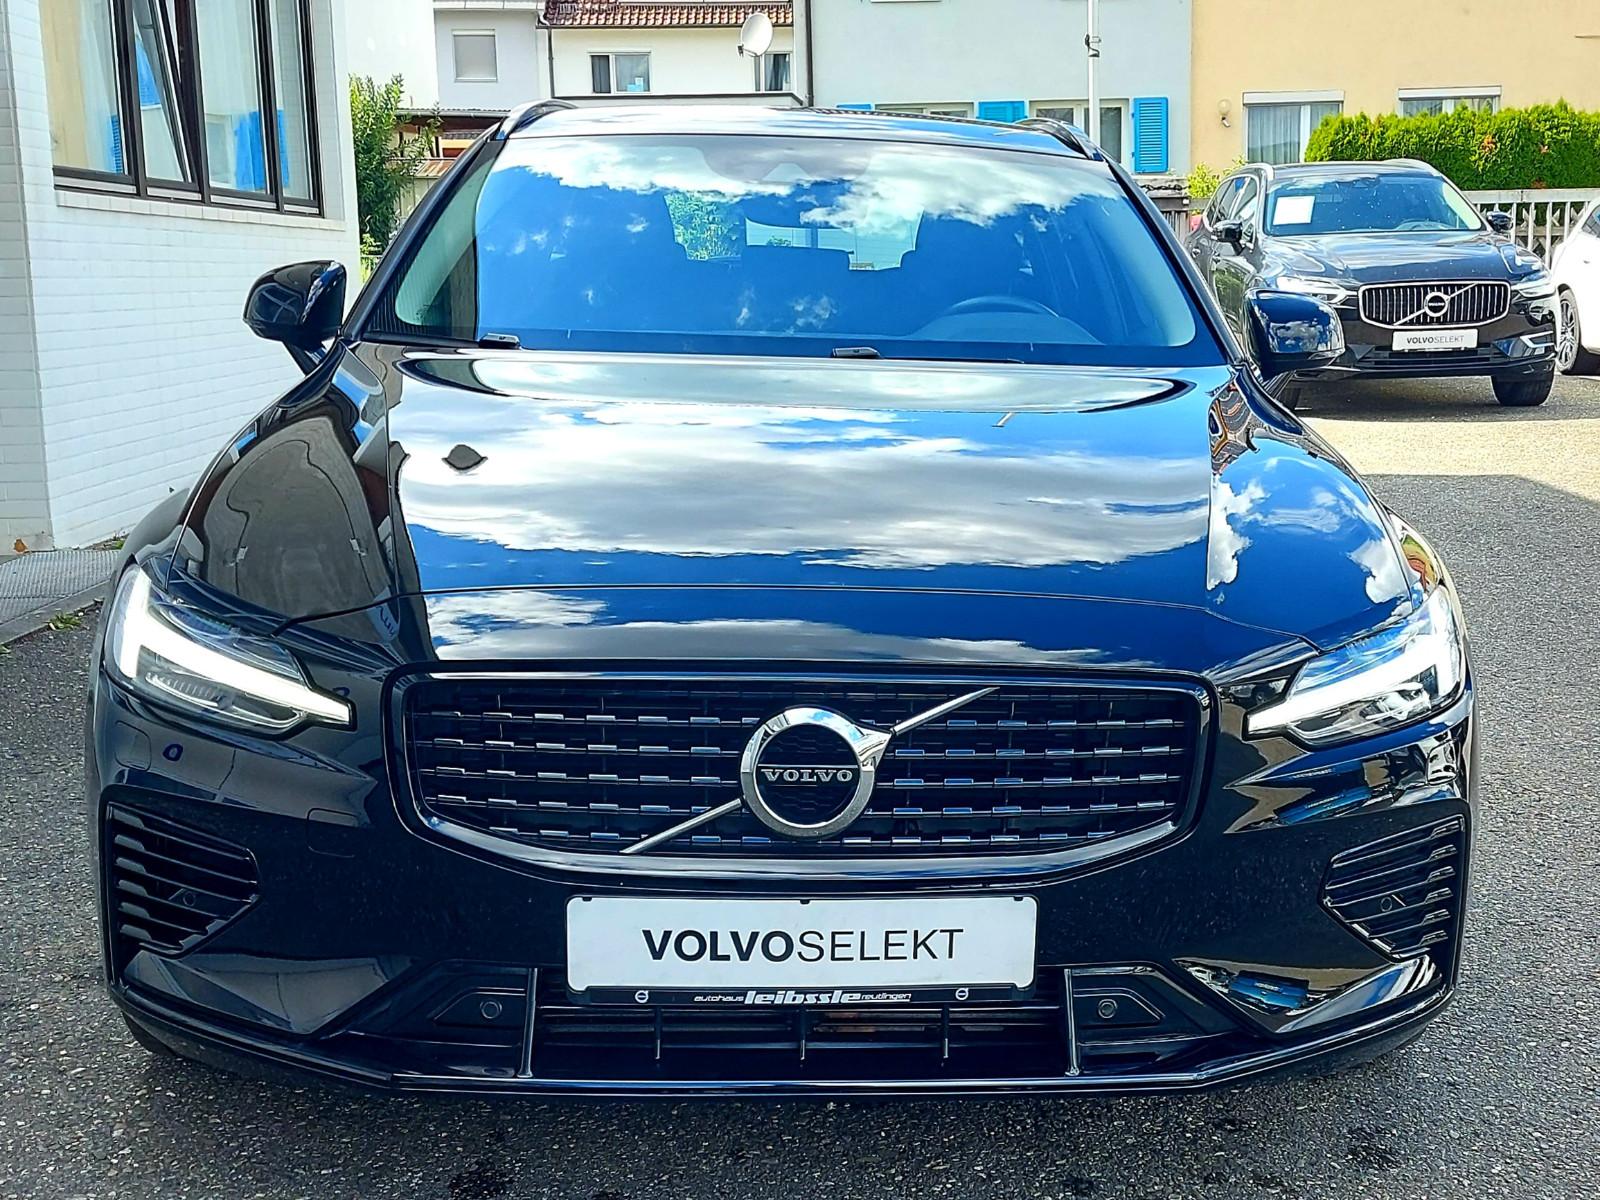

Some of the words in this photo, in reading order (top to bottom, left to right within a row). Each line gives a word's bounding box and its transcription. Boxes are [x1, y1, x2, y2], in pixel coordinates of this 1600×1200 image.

[1407, 335, 1464, 344] VOLVOSELEKT
[761, 769, 852, 782] VOLVO
[642, 928, 964, 962] VOLVOSELEKT
[694, 994, 744, 1002] autohaus
[744, 990, 861, 1004] leibssle
[861, 992, 912, 1000] reutlingen
